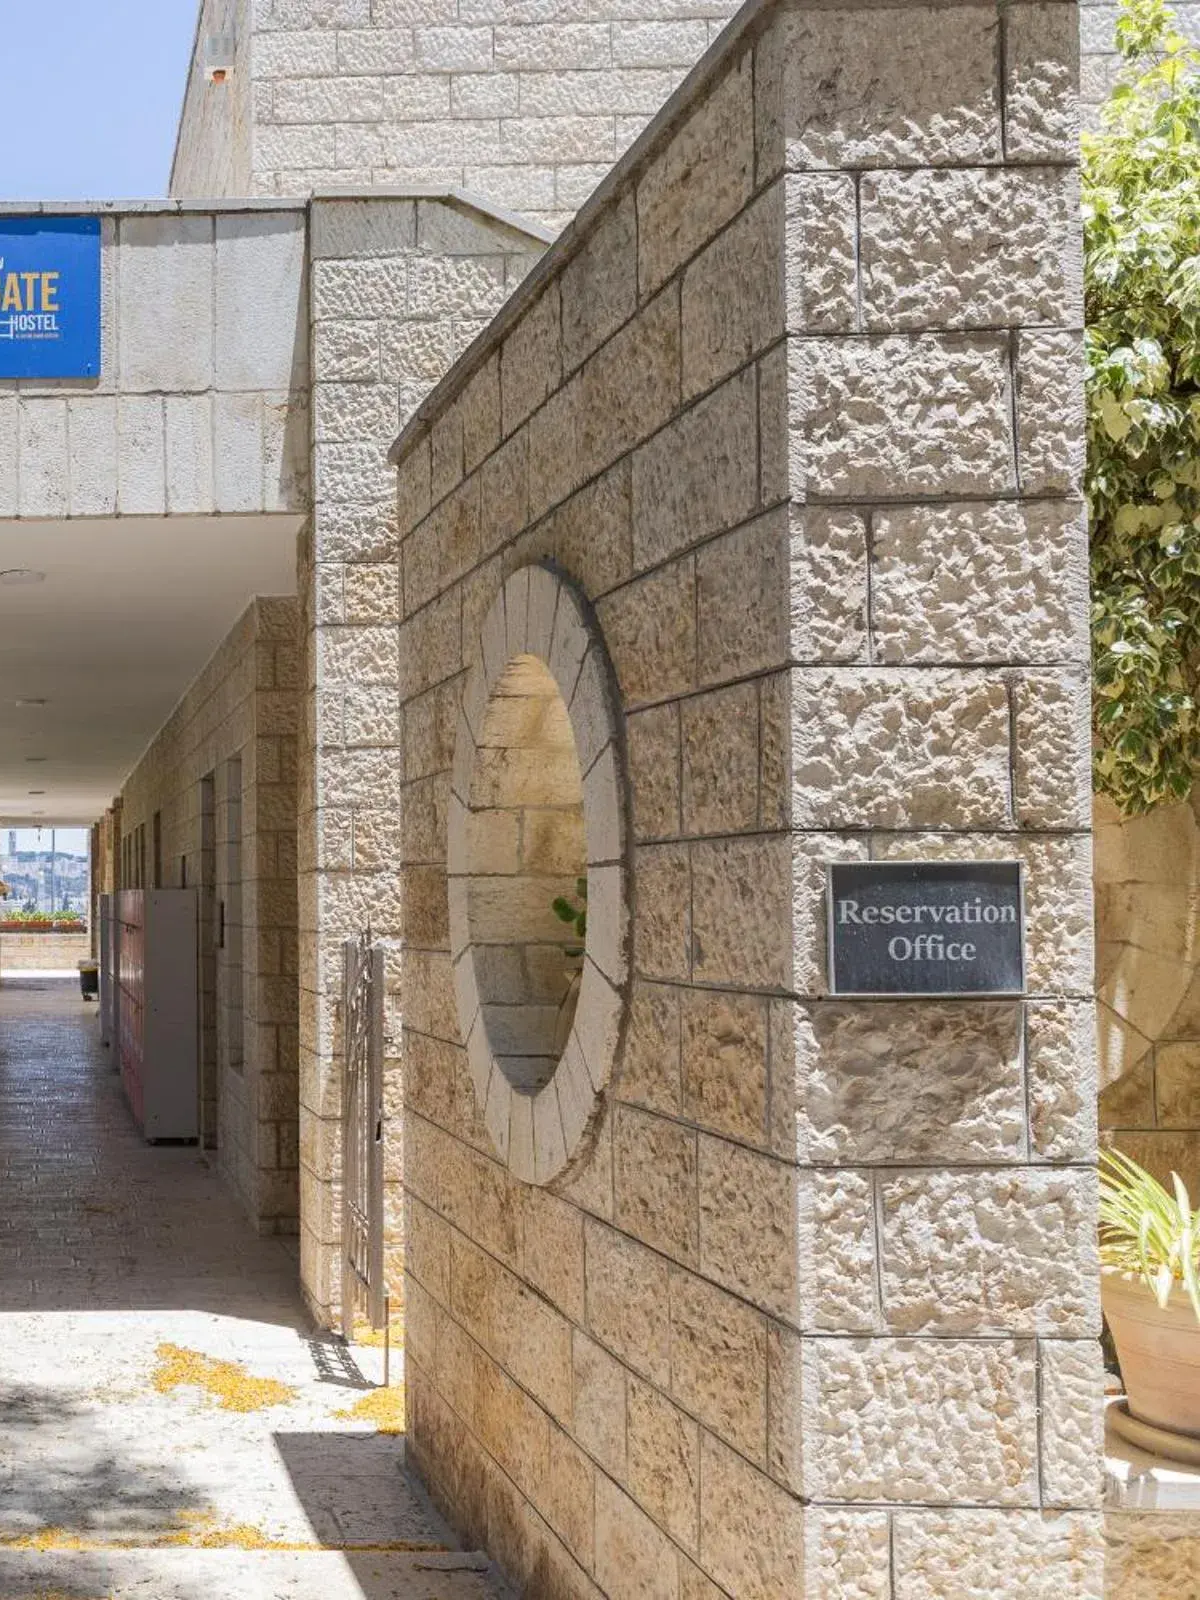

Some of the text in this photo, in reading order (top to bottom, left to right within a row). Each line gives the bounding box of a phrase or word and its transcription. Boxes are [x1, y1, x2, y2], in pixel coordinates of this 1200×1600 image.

[11, 314, 59, 331] HOSTEL
[837, 897, 1017, 925] Reservation
[888, 934, 977, 961] Office
